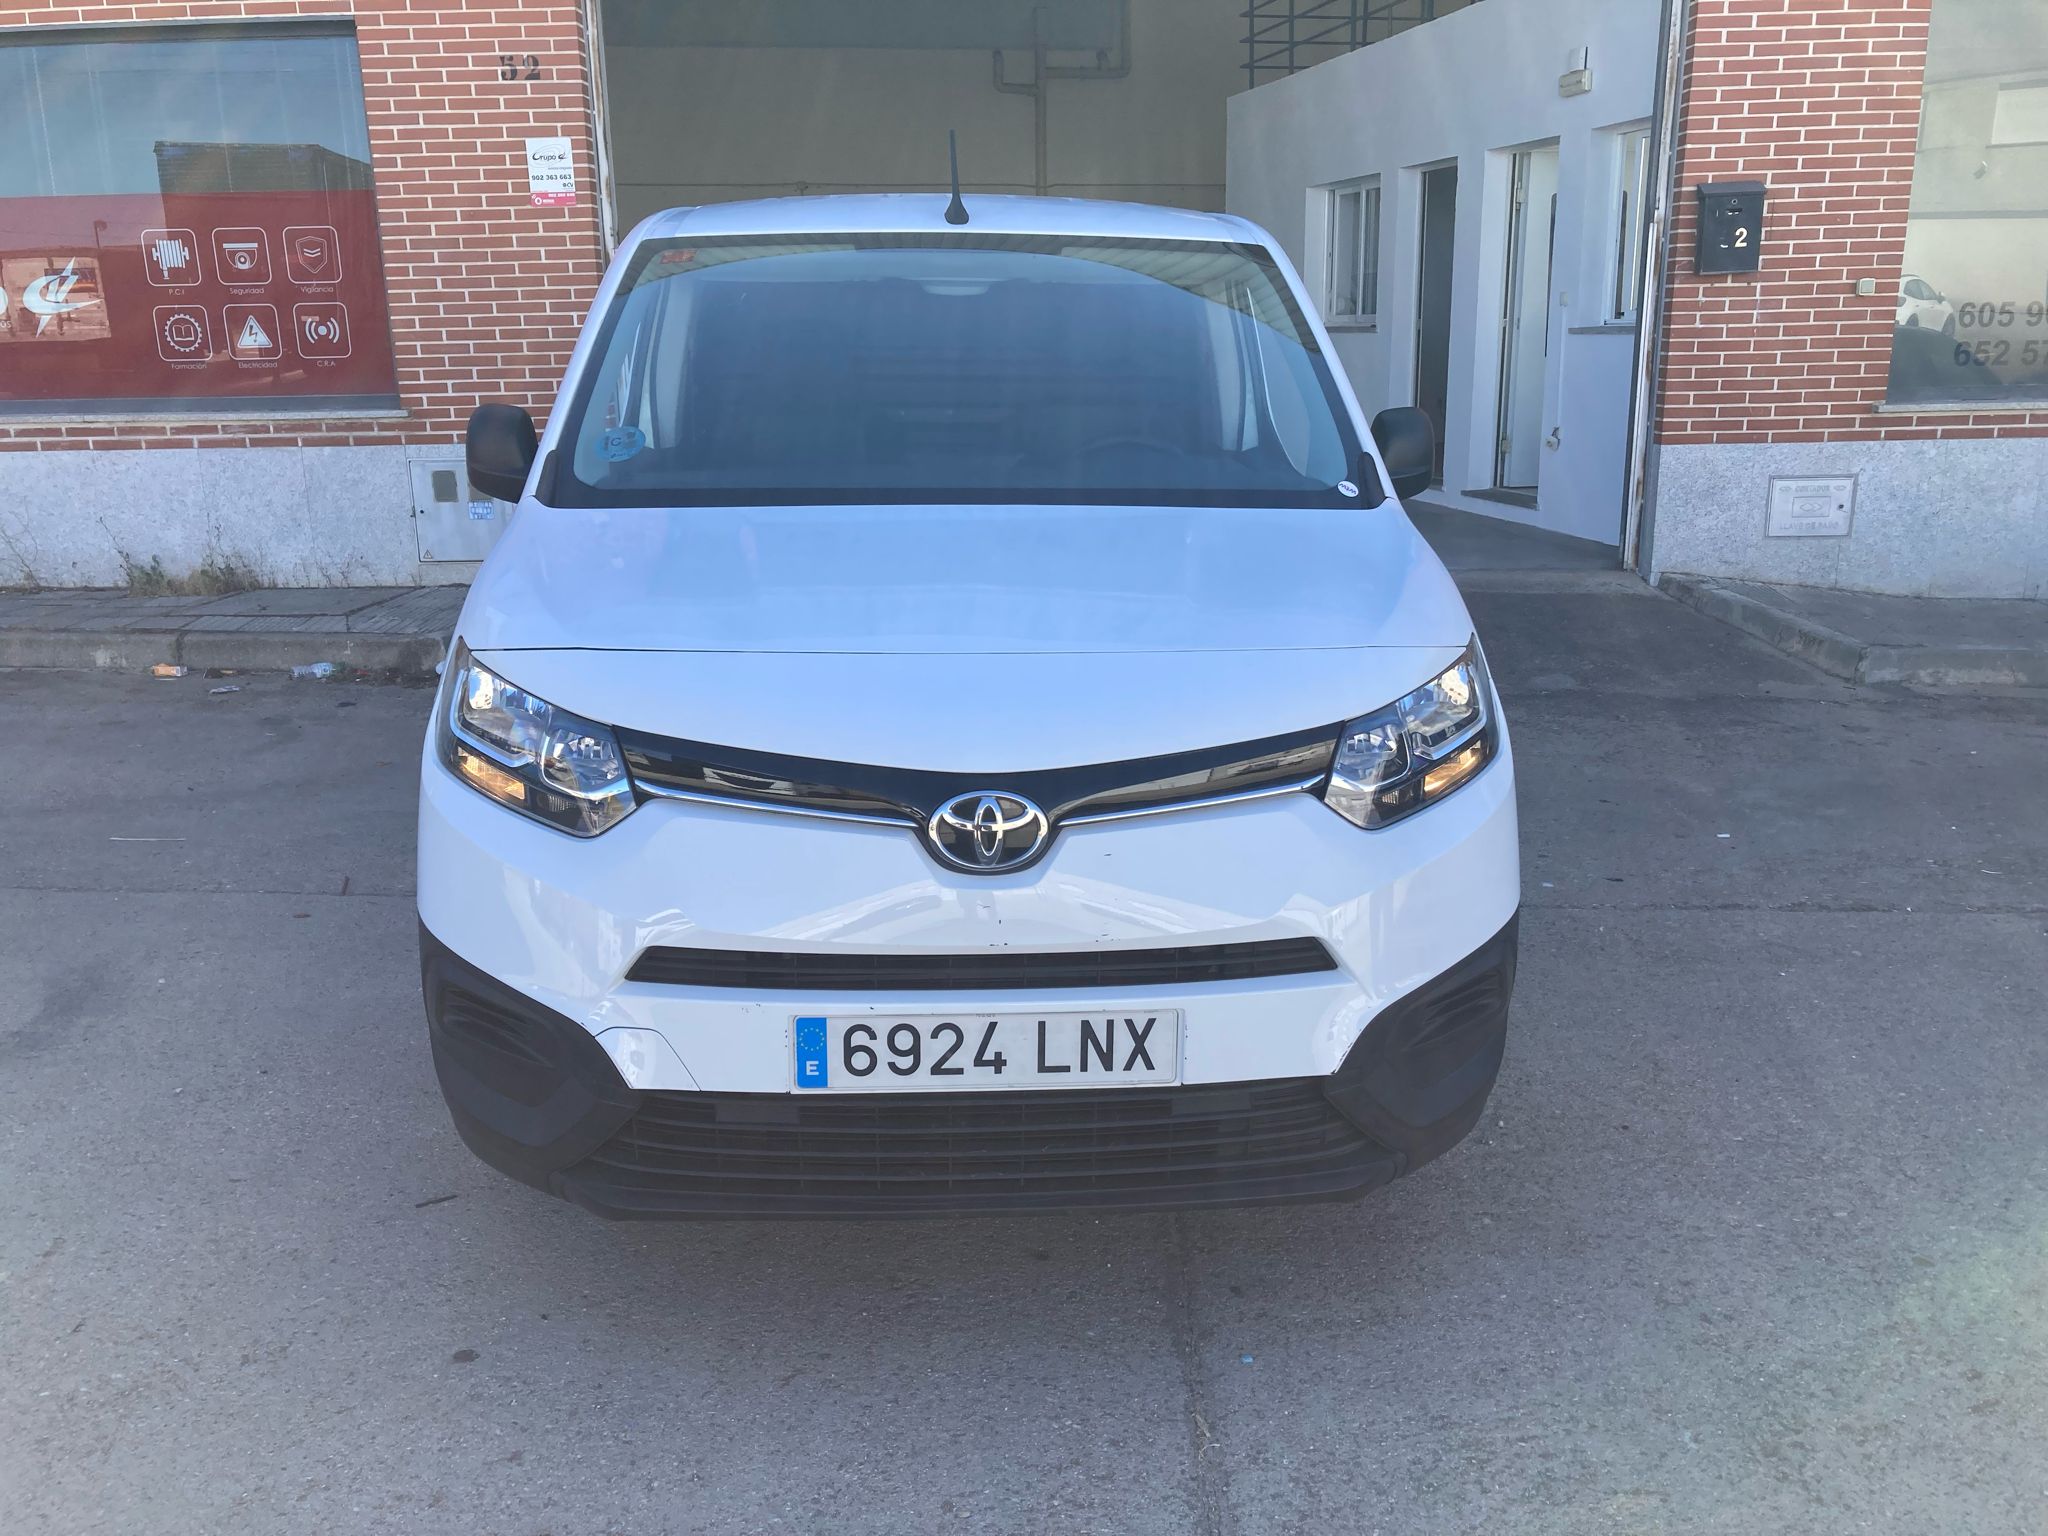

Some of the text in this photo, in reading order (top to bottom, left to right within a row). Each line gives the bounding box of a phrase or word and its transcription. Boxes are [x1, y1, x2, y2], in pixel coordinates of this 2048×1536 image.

[499, 54, 541, 81] 52
[229, 287, 265, 296] Seguridad
[300, 285, 334, 294] Vigilancia
[1958, 300, 2048, 328] 605 9
[1954, 340, 2011, 367] 652
[171, 362, 207, 370] Formación
[238, 361, 278, 370] Electricidad
[805, 1017, 1157, 1077] E 6924 LNX
